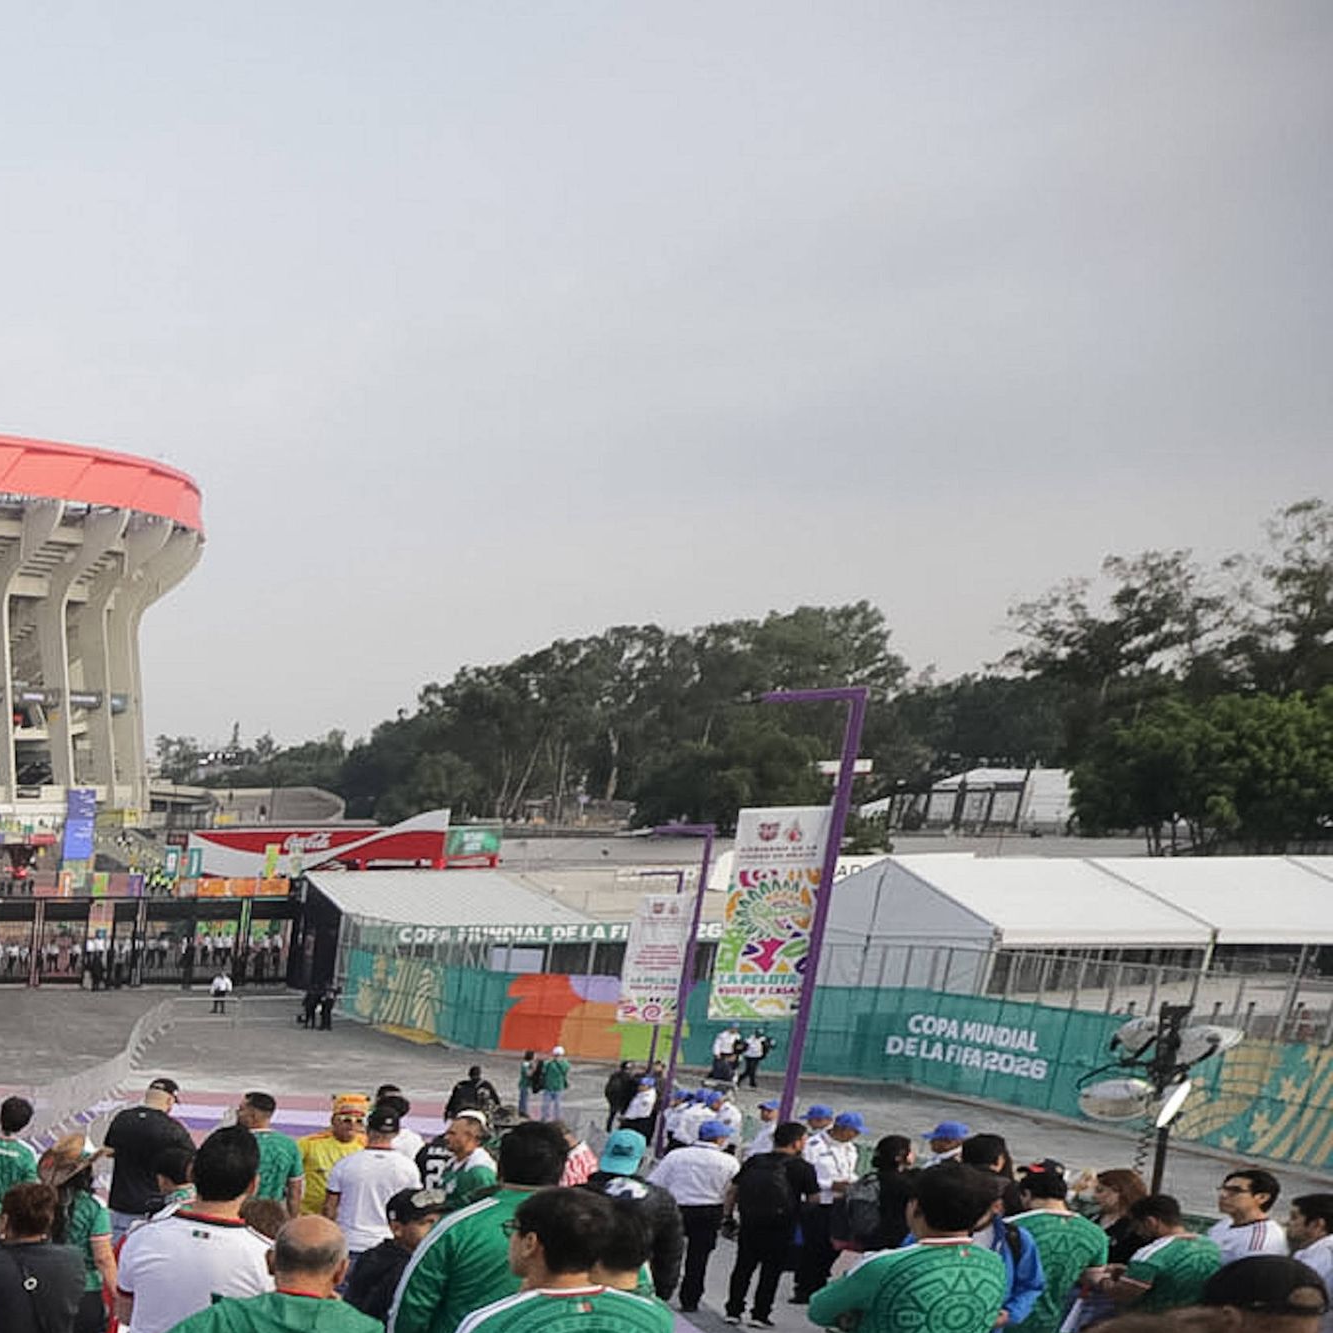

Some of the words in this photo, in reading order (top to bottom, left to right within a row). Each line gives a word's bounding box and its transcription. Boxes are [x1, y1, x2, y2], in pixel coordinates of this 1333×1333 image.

[399, 926, 451, 943] COPA
[551, 924, 579, 940] DE
[581, 924, 606, 940] LA
[907, 1014, 960, 1039] COPA
[960, 1020, 1039, 1052] MUNDIAL
[885, 1035, 919, 1056] DE
[919, 1038, 943, 1061] LA
[944, 1043, 983, 1068] FIFA
[983, 1050, 1048, 1080] 2026
